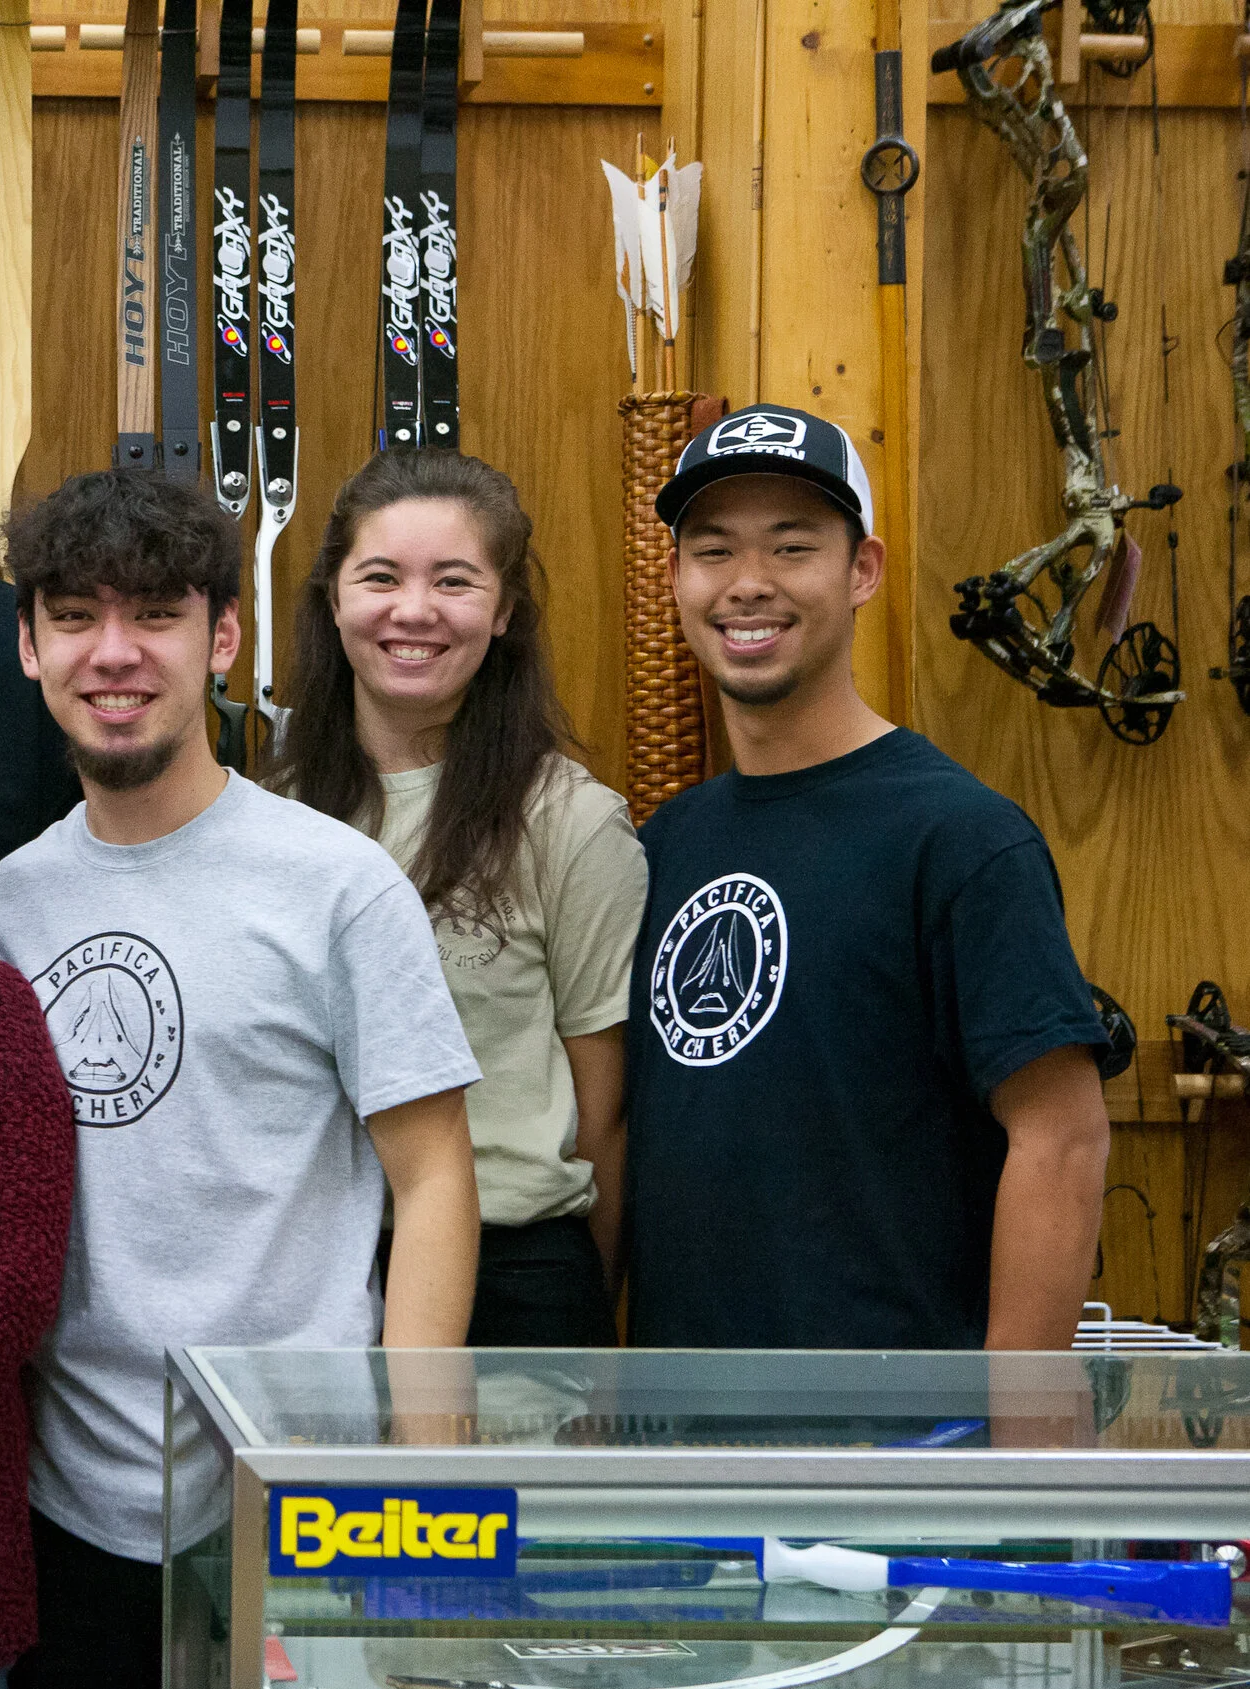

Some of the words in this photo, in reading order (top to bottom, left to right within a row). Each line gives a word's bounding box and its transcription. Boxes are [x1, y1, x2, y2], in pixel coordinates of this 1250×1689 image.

[132, 148, 144, 234] TRADITIONAL
[173, 146, 184, 232] TRADITIONAL
[124, 235, 145, 367] HOYT
[165, 233, 190, 366] HOYT
[215, 186, 251, 322] GALAXY
[259, 193, 295, 329] GALAXY
[384, 195, 420, 331] GALAXY
[420, 190, 457, 324] GALAXY
[679, 883, 776, 931] PACIFICA
[48, 941, 160, 989] PACIFICA
[664, 1013, 751, 1058] ARCHERY
[281, 1496, 508, 1568] Beiter
